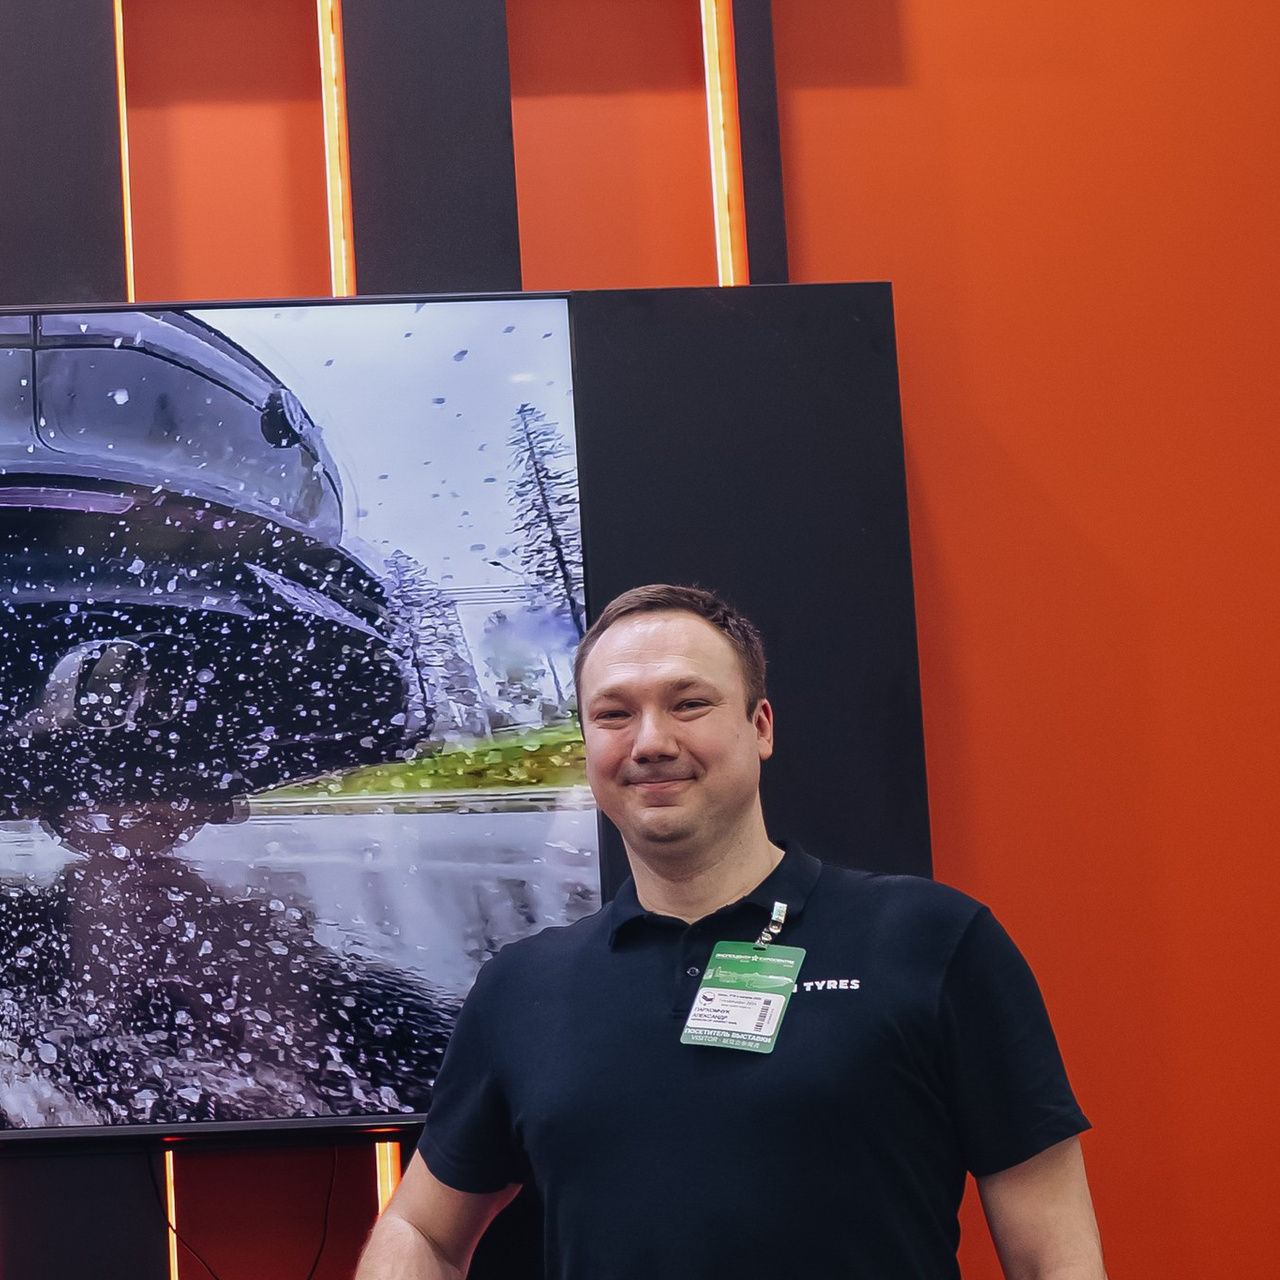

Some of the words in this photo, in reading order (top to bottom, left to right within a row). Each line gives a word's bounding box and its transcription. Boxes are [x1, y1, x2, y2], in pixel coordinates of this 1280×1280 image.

[803, 979, 860, 991] TYRES
[684, 1028, 730, 1038] ПОСЕТИТЕЛЬ
[731, 1032, 772, 1043] ВЫСТАВКИ
